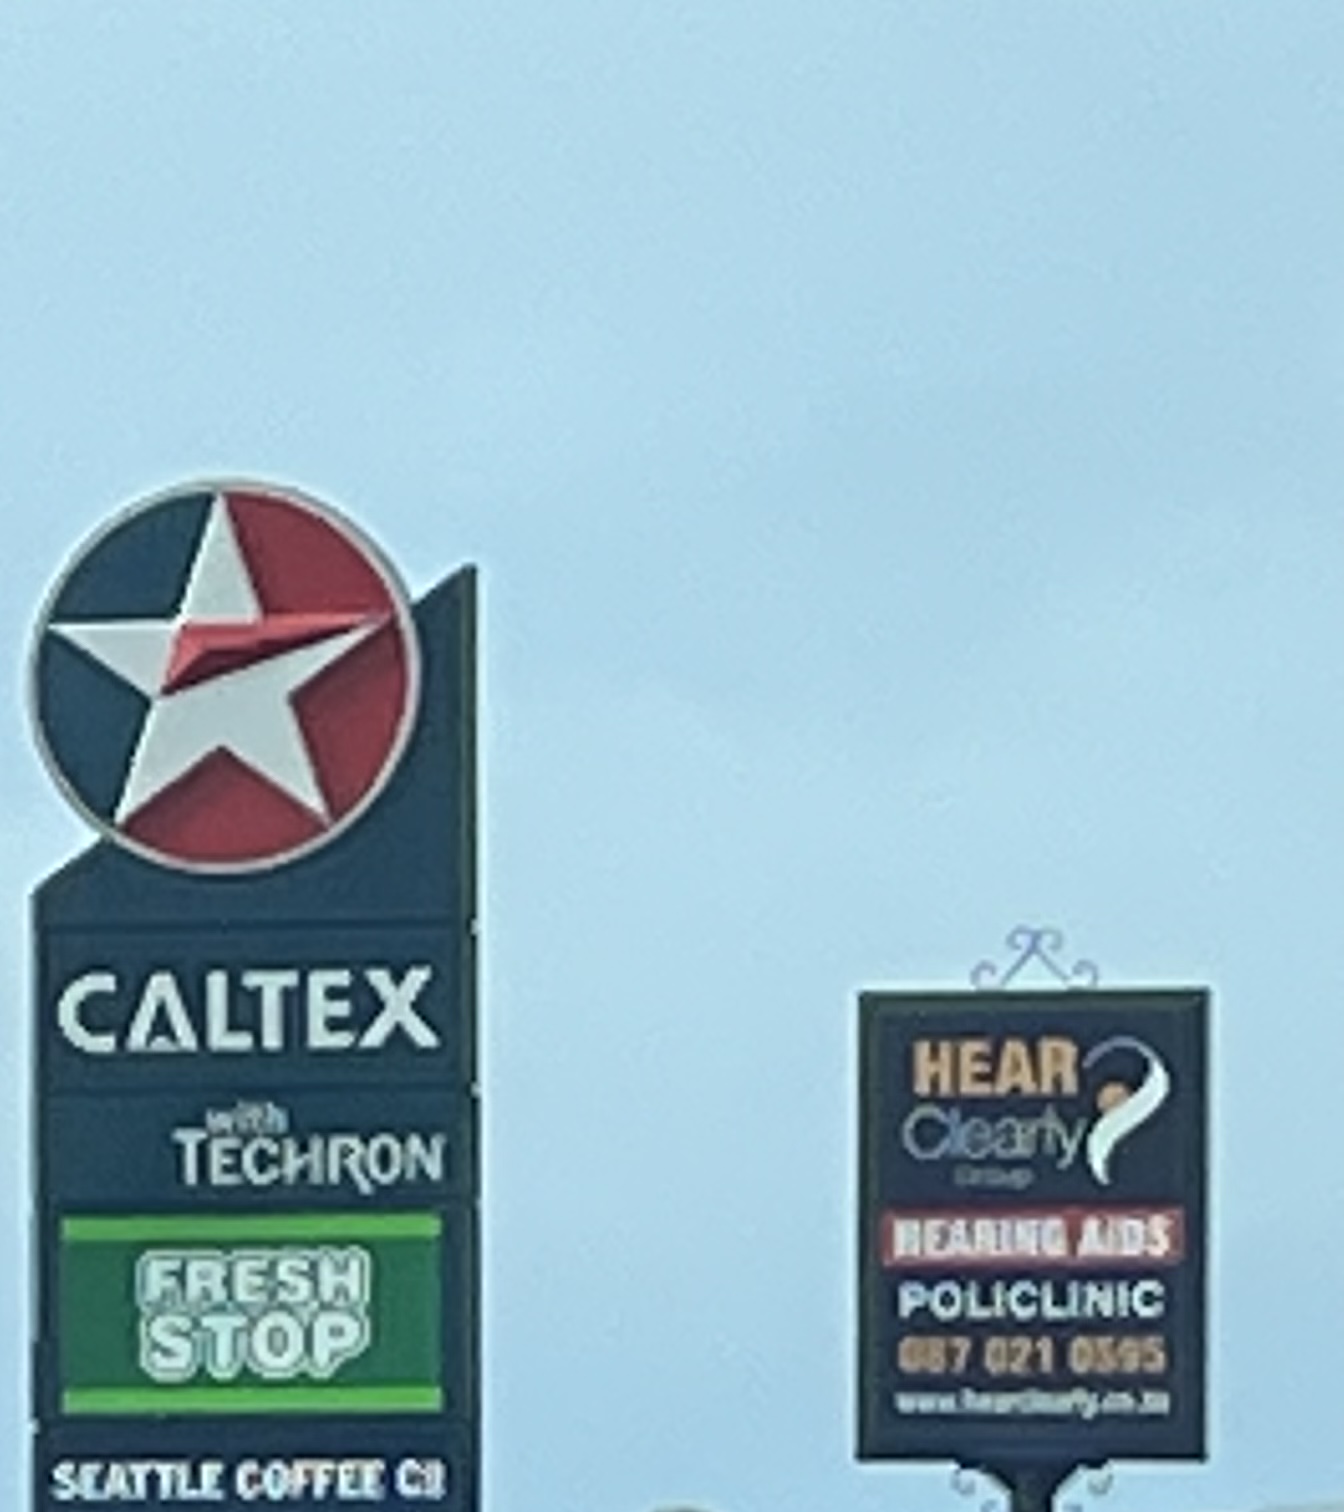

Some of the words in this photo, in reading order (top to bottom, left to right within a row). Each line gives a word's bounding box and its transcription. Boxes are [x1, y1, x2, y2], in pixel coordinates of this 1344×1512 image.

[56, 966, 441, 1053] CALTEX
[913, 1036, 1079, 1095] HEAR
[206, 1101, 290, 1136] with
[902, 1103, 1088, 1168] Clearly
[171, 1126, 448, 1193] TECHRON
[893, 1217, 1066, 1257] HEARING
[1076, 1214, 1171, 1257] AIDS
[139, 1249, 367, 1303] FRESH
[897, 1279, 1166, 1320] POLICLINIC
[141, 1309, 367, 1377] STOP
[50, 1461, 224, 1501] SEATTLE
[235, 1459, 387, 1500] COFFEE
